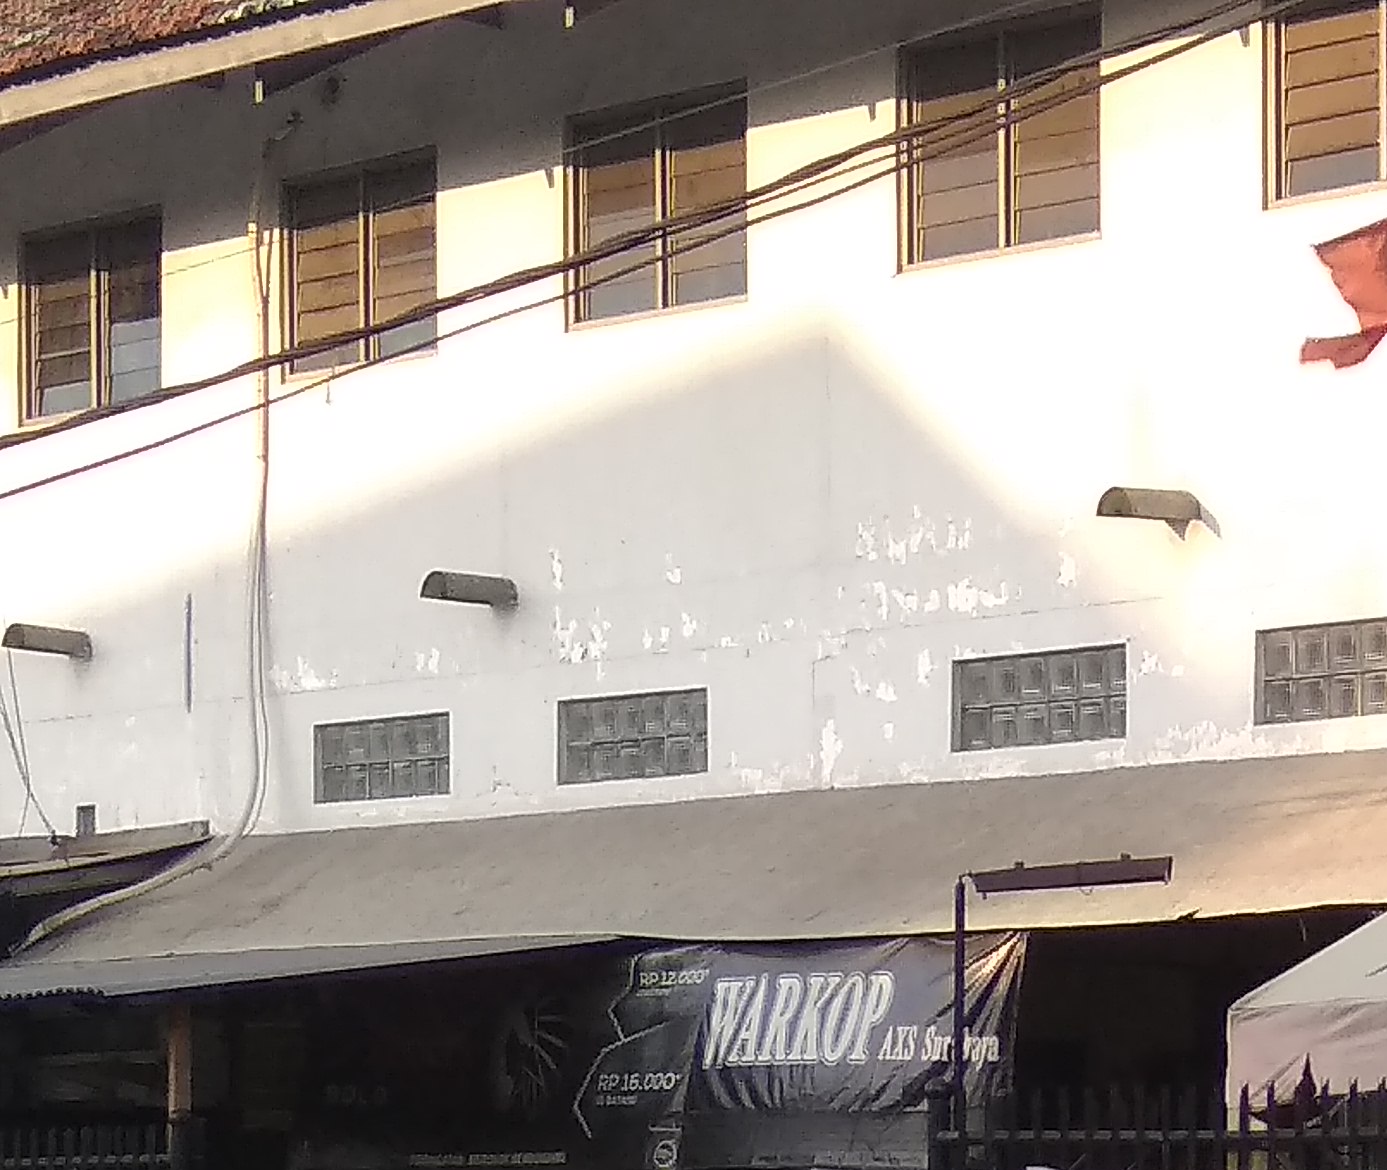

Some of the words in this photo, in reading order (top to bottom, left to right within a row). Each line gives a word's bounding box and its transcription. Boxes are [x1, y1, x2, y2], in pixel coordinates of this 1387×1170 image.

[702, 971, 895, 1069] WARKOP
[878, 1026, 918, 1061] AXS
[597, 1073, 621, 1092] RP
